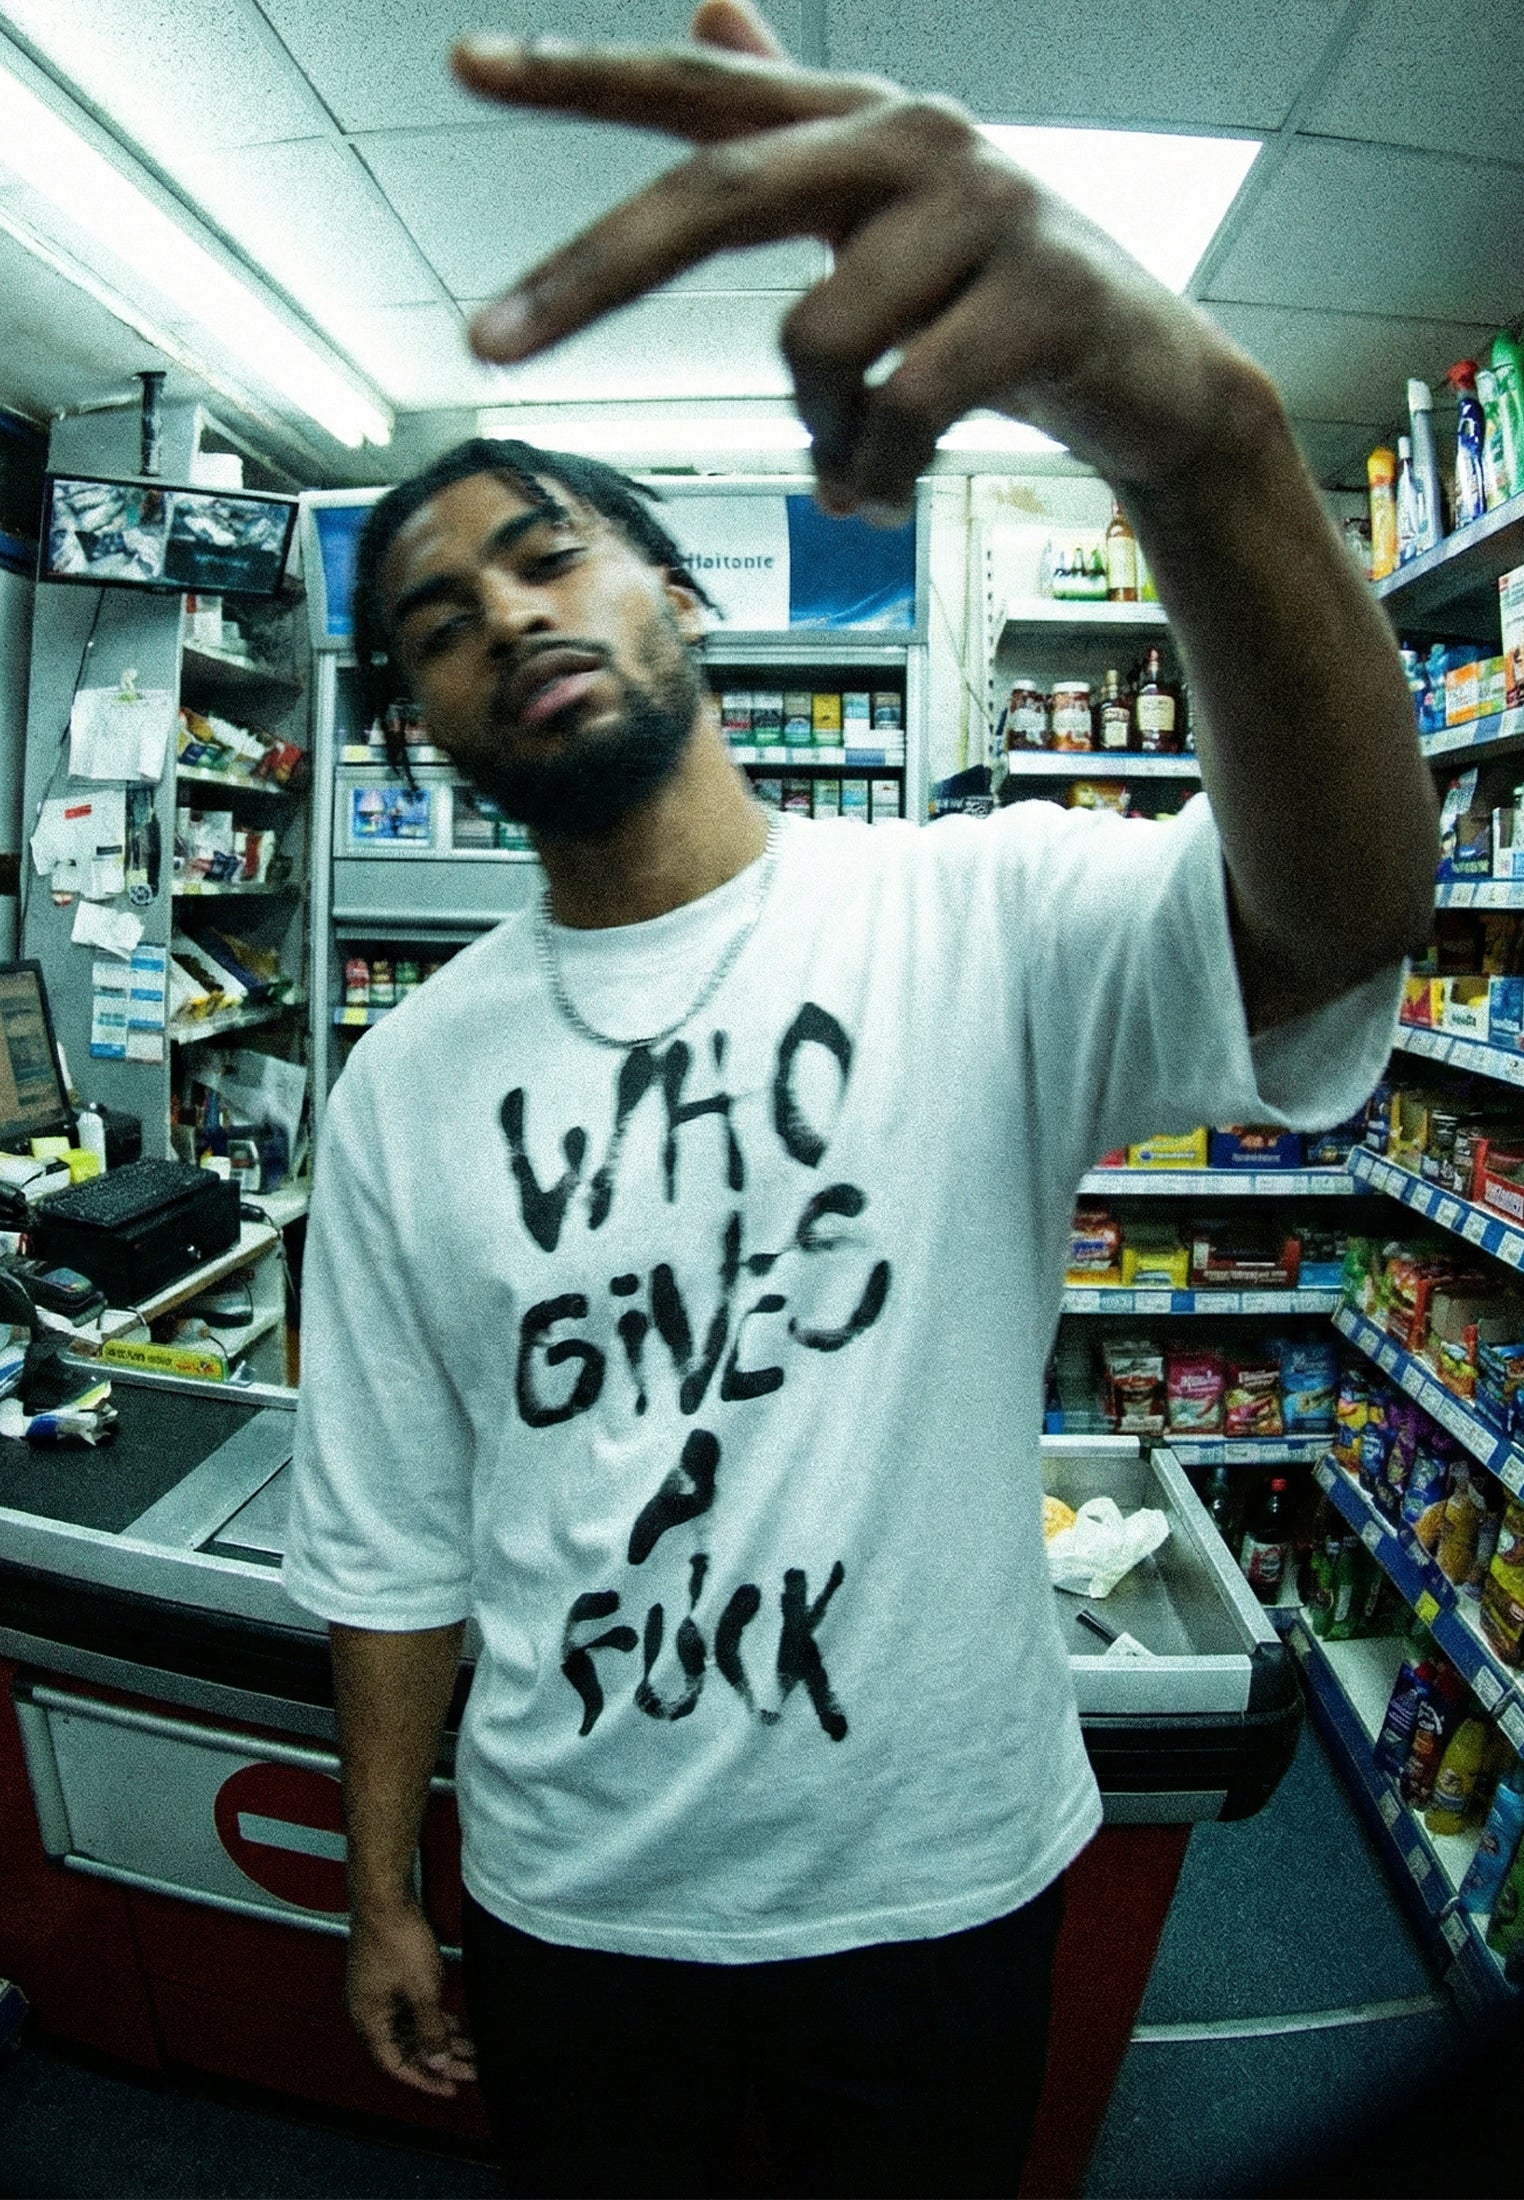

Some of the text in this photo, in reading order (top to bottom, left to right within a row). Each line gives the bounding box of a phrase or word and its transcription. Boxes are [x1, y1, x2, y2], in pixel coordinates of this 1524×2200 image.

[500, 1001, 852, 1252] WHO
[626, 1427, 722, 1566] A
[561, 1551, 850, 1743] FUCK
